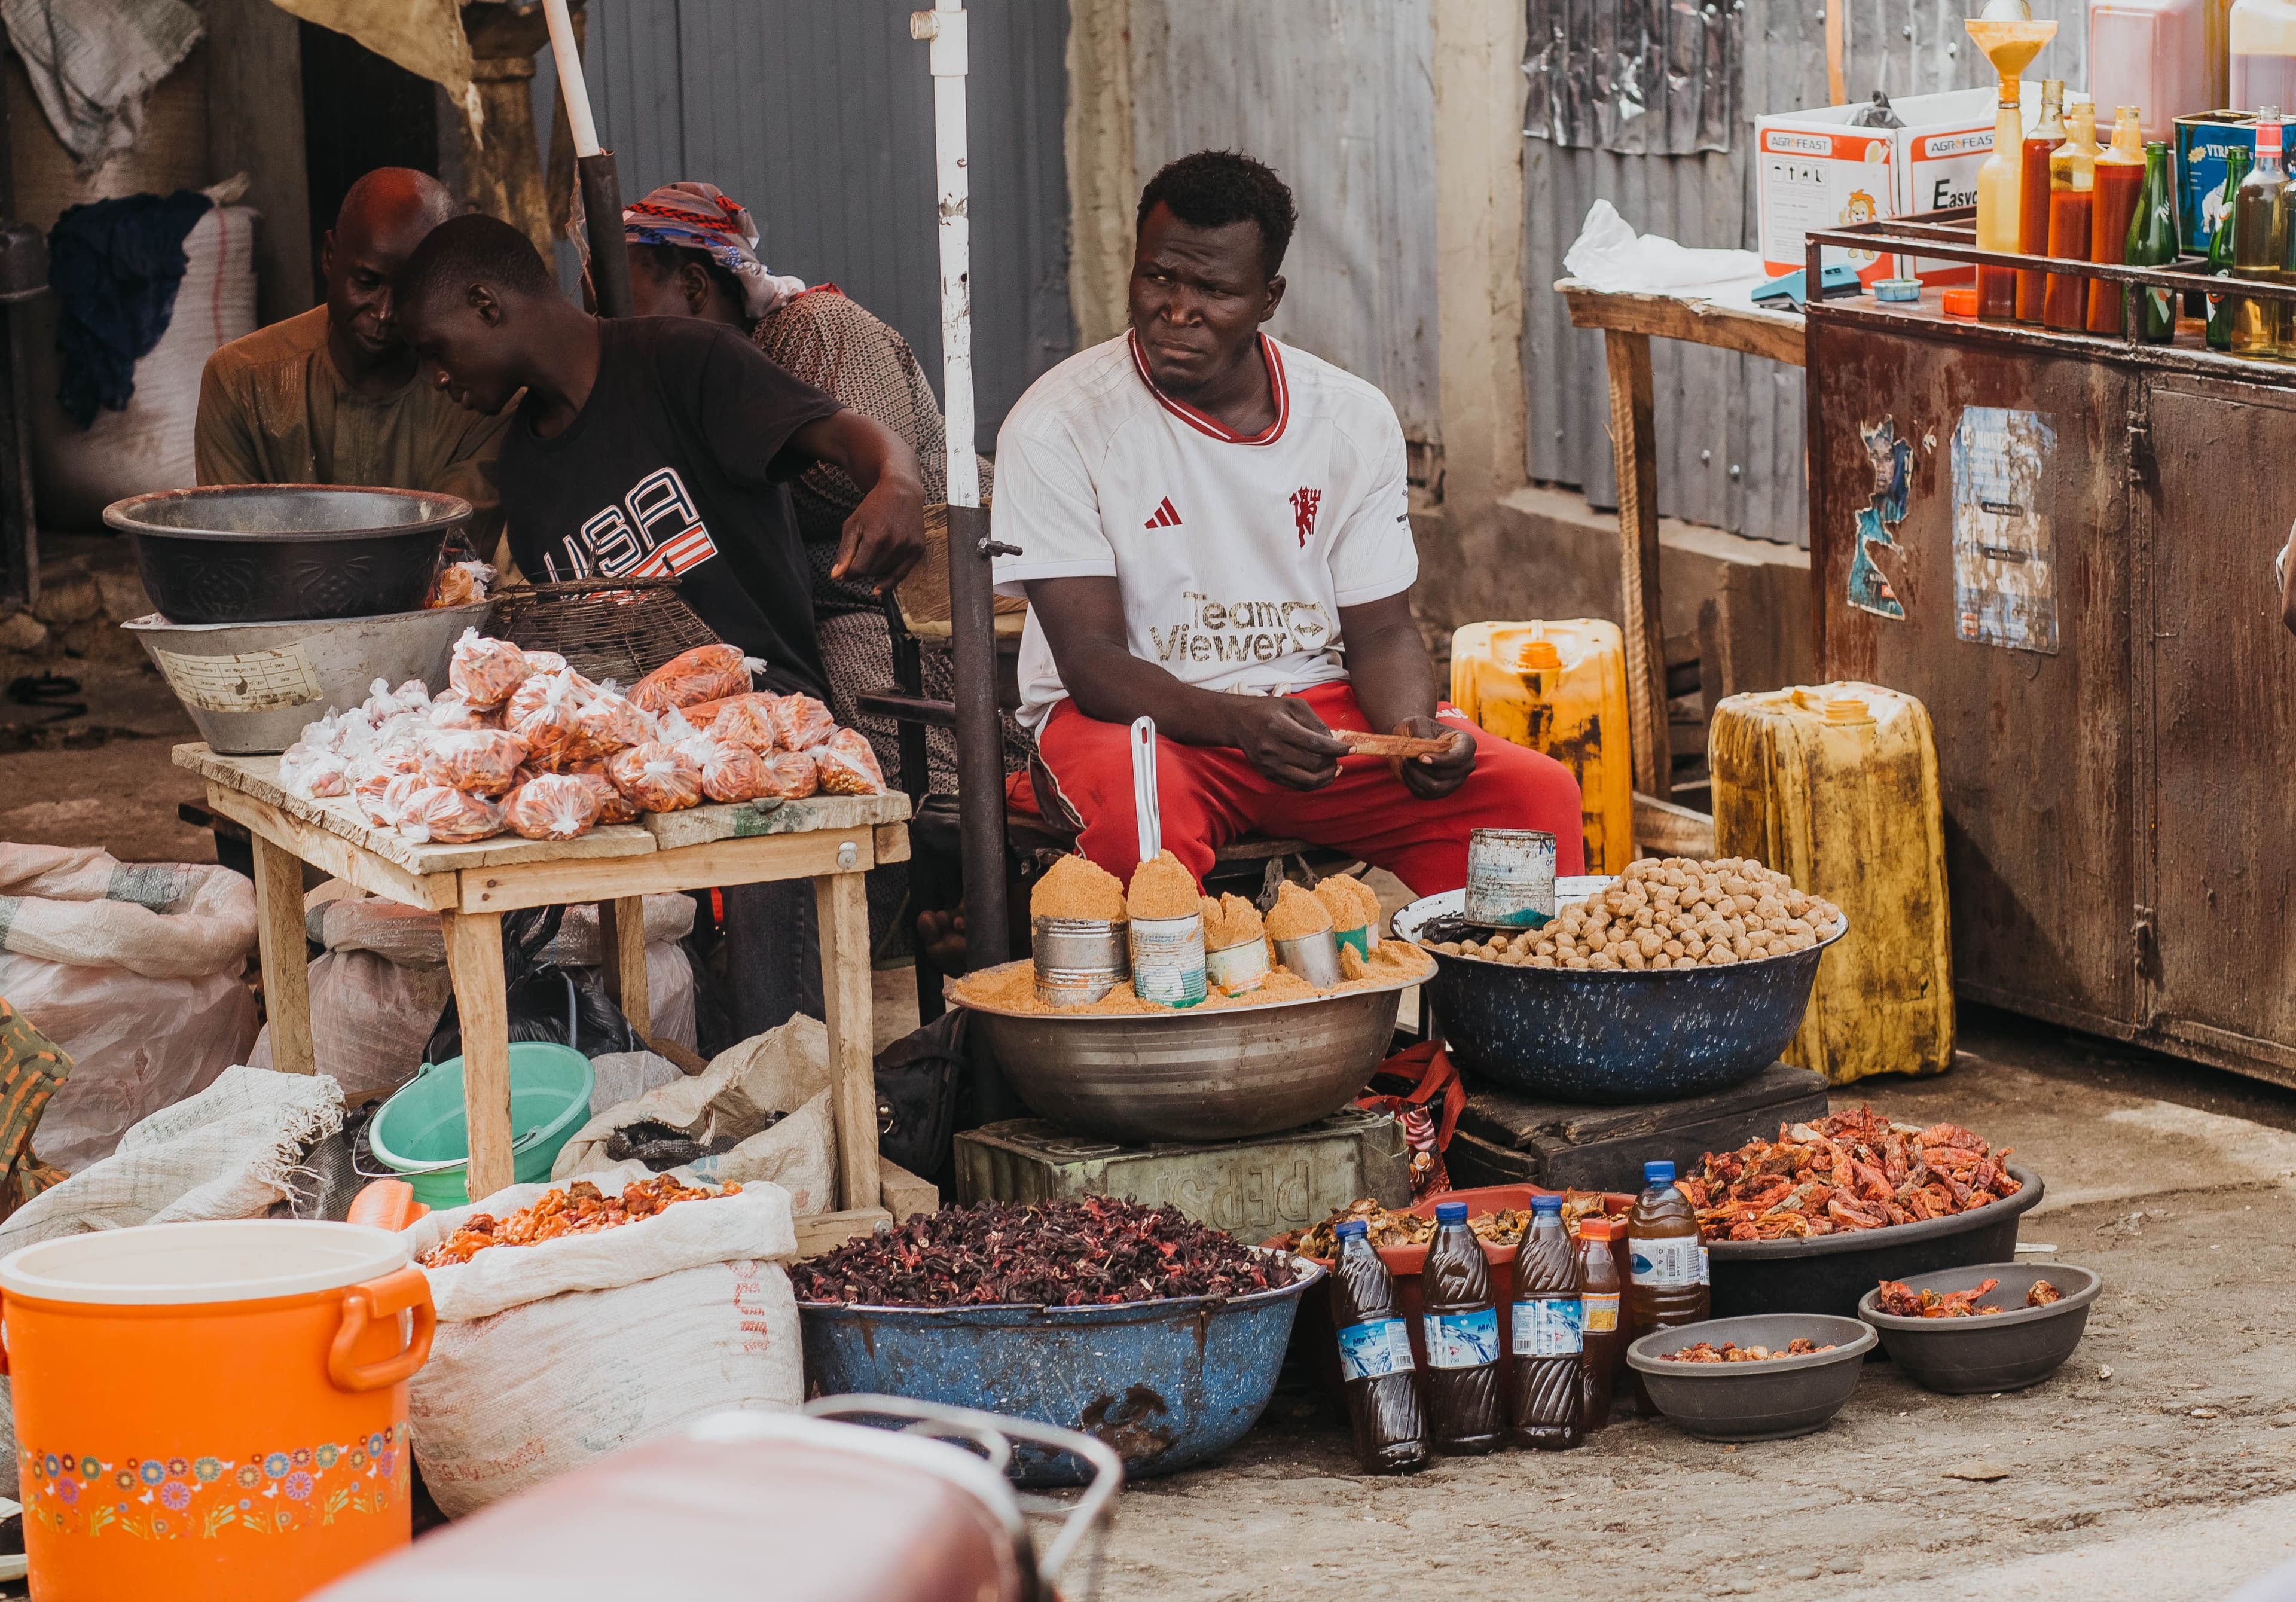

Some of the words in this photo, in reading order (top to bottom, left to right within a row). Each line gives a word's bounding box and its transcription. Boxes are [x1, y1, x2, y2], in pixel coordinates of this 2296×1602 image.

[1772, 135, 1828, 151] AGROFEAST
[544, 466, 700, 583] USA
[1183, 591, 1283, 630] Team
[1149, 623, 1287, 662] Viewer
